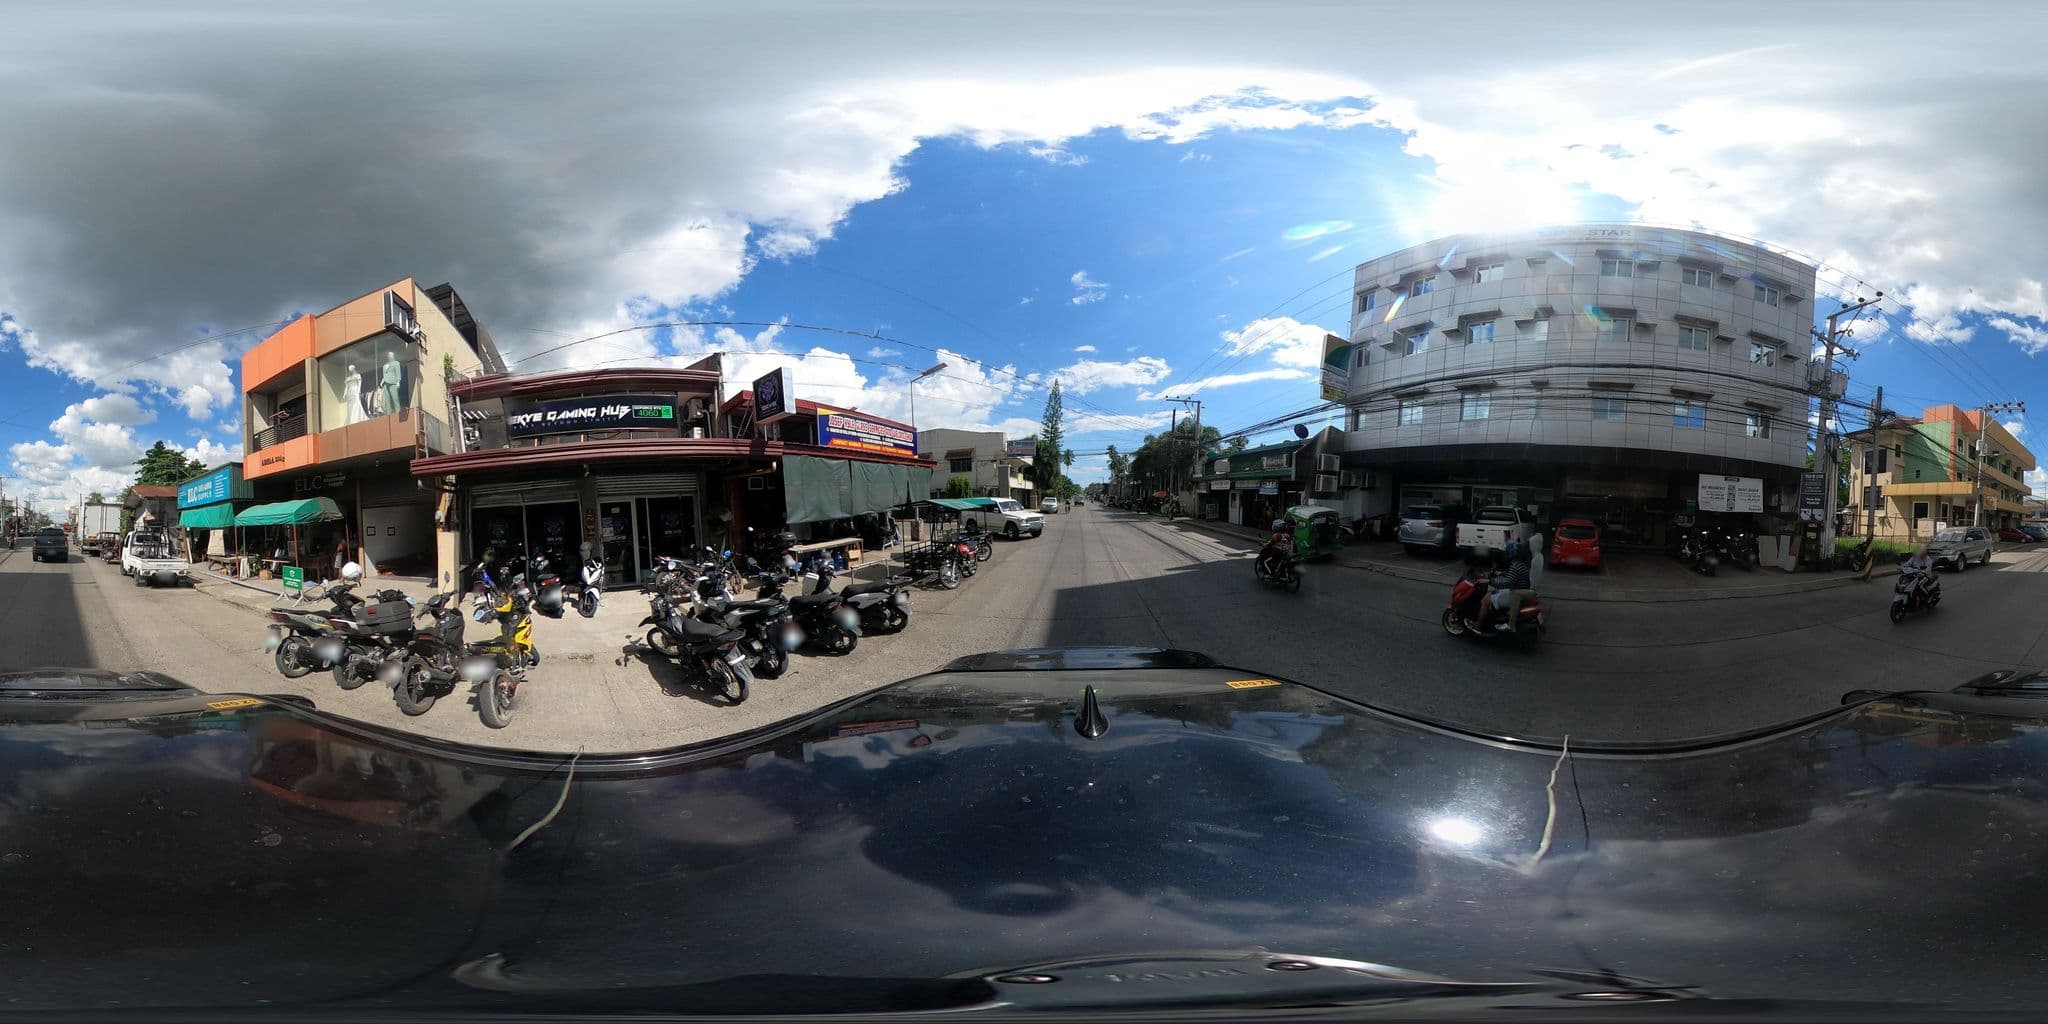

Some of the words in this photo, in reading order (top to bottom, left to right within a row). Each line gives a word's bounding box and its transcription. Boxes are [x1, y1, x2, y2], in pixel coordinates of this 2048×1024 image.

[1590, 229, 1632, 237] STAR
[546, 407, 597, 421] GAMING
[600, 404, 632, 419] HUB
